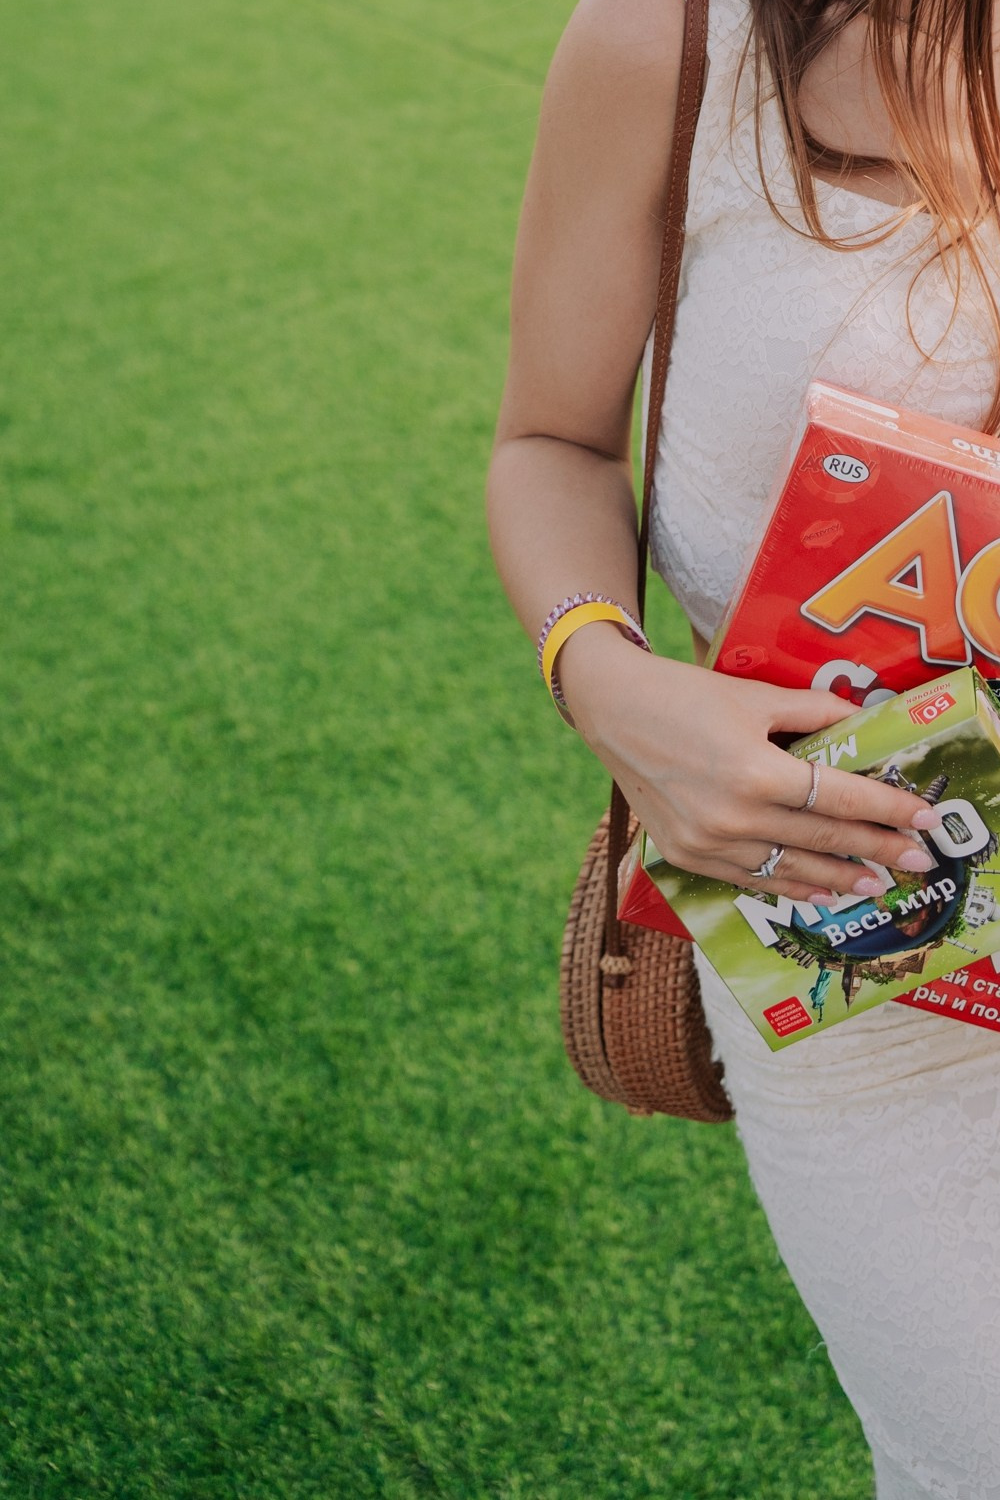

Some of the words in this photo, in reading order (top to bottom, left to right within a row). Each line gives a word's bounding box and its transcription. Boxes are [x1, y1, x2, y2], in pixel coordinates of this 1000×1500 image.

[828, 457, 864, 479] RUS
[735, 649, 753, 668] 5
[906, 683, 951, 704] карточек
[923, 696, 949, 719] 50
[821, 906, 893, 947] Весь
[895, 876, 957, 915] мир
[951, 995, 967, 1012] и
